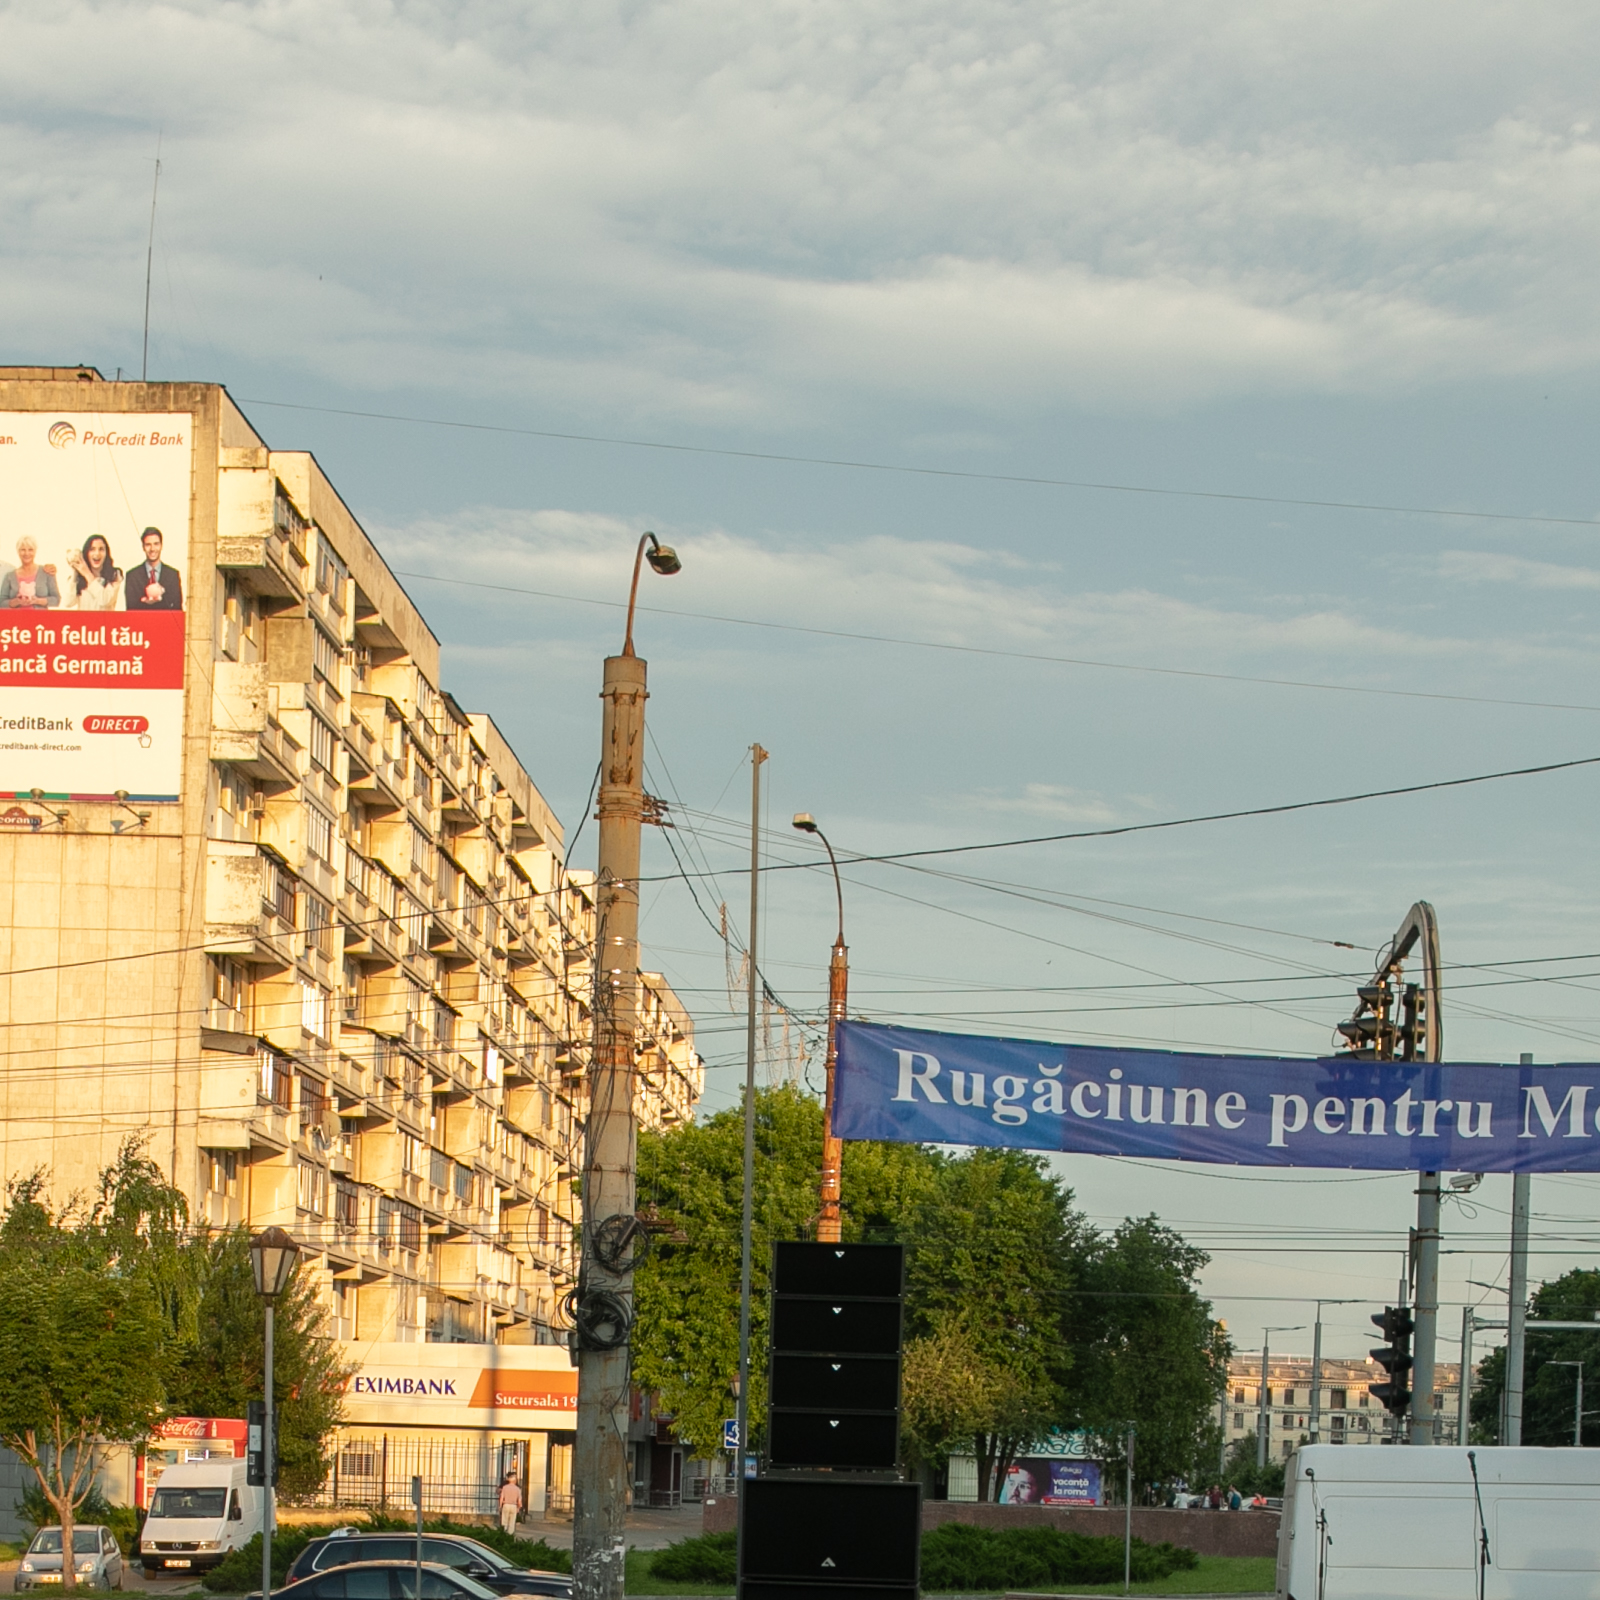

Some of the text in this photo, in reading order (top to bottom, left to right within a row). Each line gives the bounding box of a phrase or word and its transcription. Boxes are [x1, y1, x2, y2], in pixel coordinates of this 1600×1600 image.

[82, 431, 184, 446] ProCredit Bank
[36, 624, 56, 645] în
[61, 625, 106, 646] felul
[111, 627, 151, 649] tău,
[53, 655, 144, 676] Germană
[91, 719, 140, 731] DIRECT
[891, 1048, 1246, 1126] Rugăciune
[1267, 1087, 1494, 1147] pentru
[355, 1377, 456, 1395] EXIMBANK
[495, 1394, 559, 1407] Sucursala
[1054, 1486, 1088, 1496] la roma
